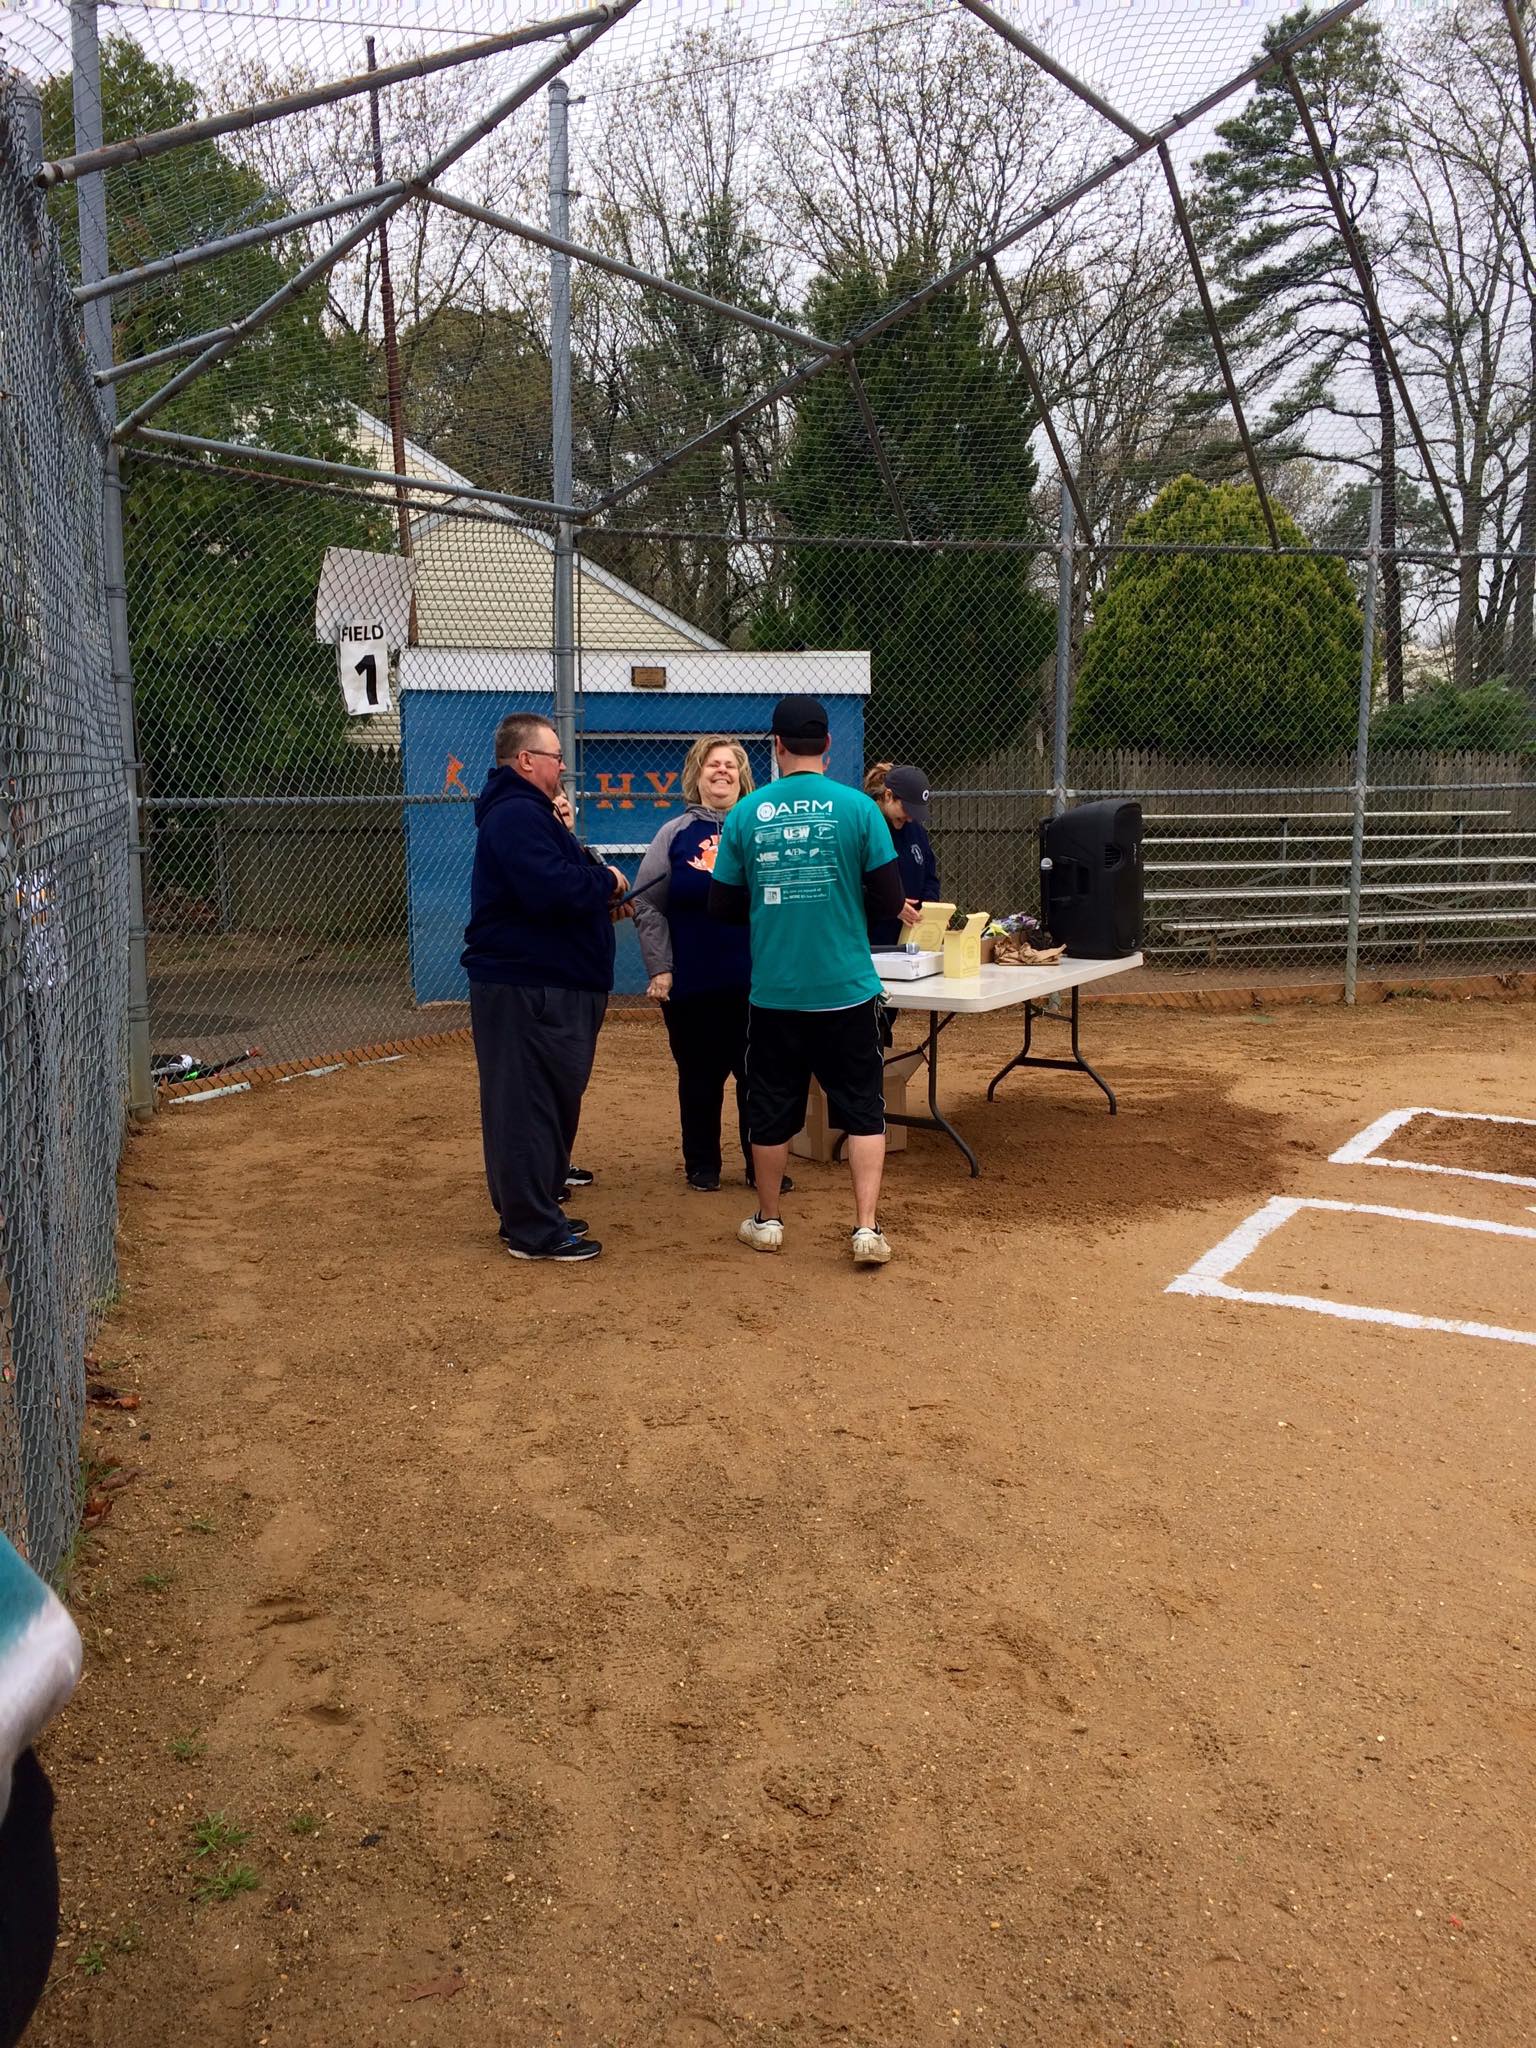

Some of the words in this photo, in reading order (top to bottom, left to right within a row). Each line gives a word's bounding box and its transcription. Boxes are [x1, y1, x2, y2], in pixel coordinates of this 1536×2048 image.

[341, 625, 384, 642] FIELD
[354, 654, 379, 705] 1
[775, 800, 833, 816] ARM
